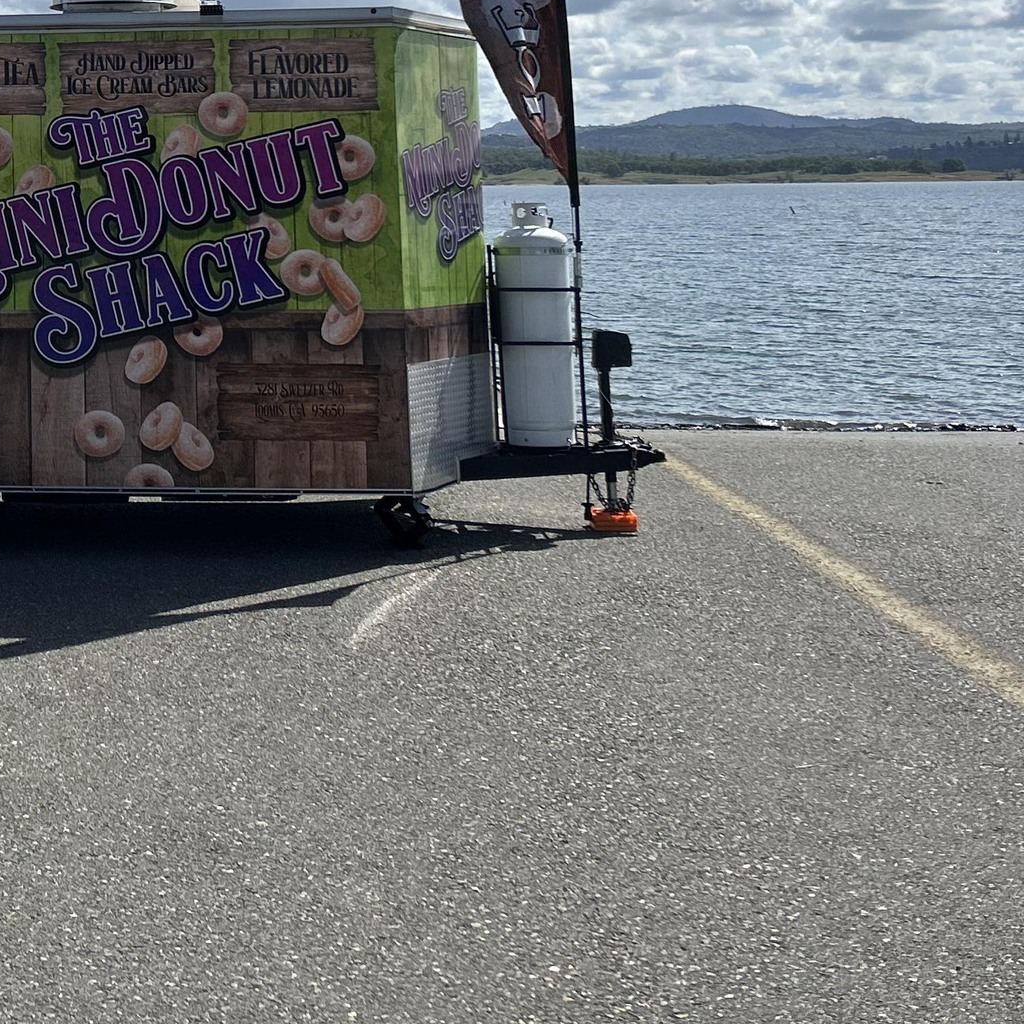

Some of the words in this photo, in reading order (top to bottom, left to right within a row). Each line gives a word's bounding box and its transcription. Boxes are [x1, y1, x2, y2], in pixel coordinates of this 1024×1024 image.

[76, 52, 126, 76] HAND
[130, 50, 194, 75] DIPPED
[248, 45, 349, 75] FLAVORED
[66, 75, 93, 95] ICE
[96, 74, 153, 101] CREAM
[157, 74, 209, 98] BARS
[253, 76, 360, 99] LEMONADE
[439, 87, 468, 125] THE
[48, 106, 152, 166] THE
[85, 118, 348, 258] DONUT
[402, 138, 453, 218] MINI
[438, 183, 483, 262] SHA
[32, 227, 288, 367] SHACK
[255, 382, 277, 397] 3281
[328, 380, 344, 396] RD
[255, 403, 285, 422] LOOMIS
[289, 403, 306, 422] CA
[311, 403, 345, 418] 95650
